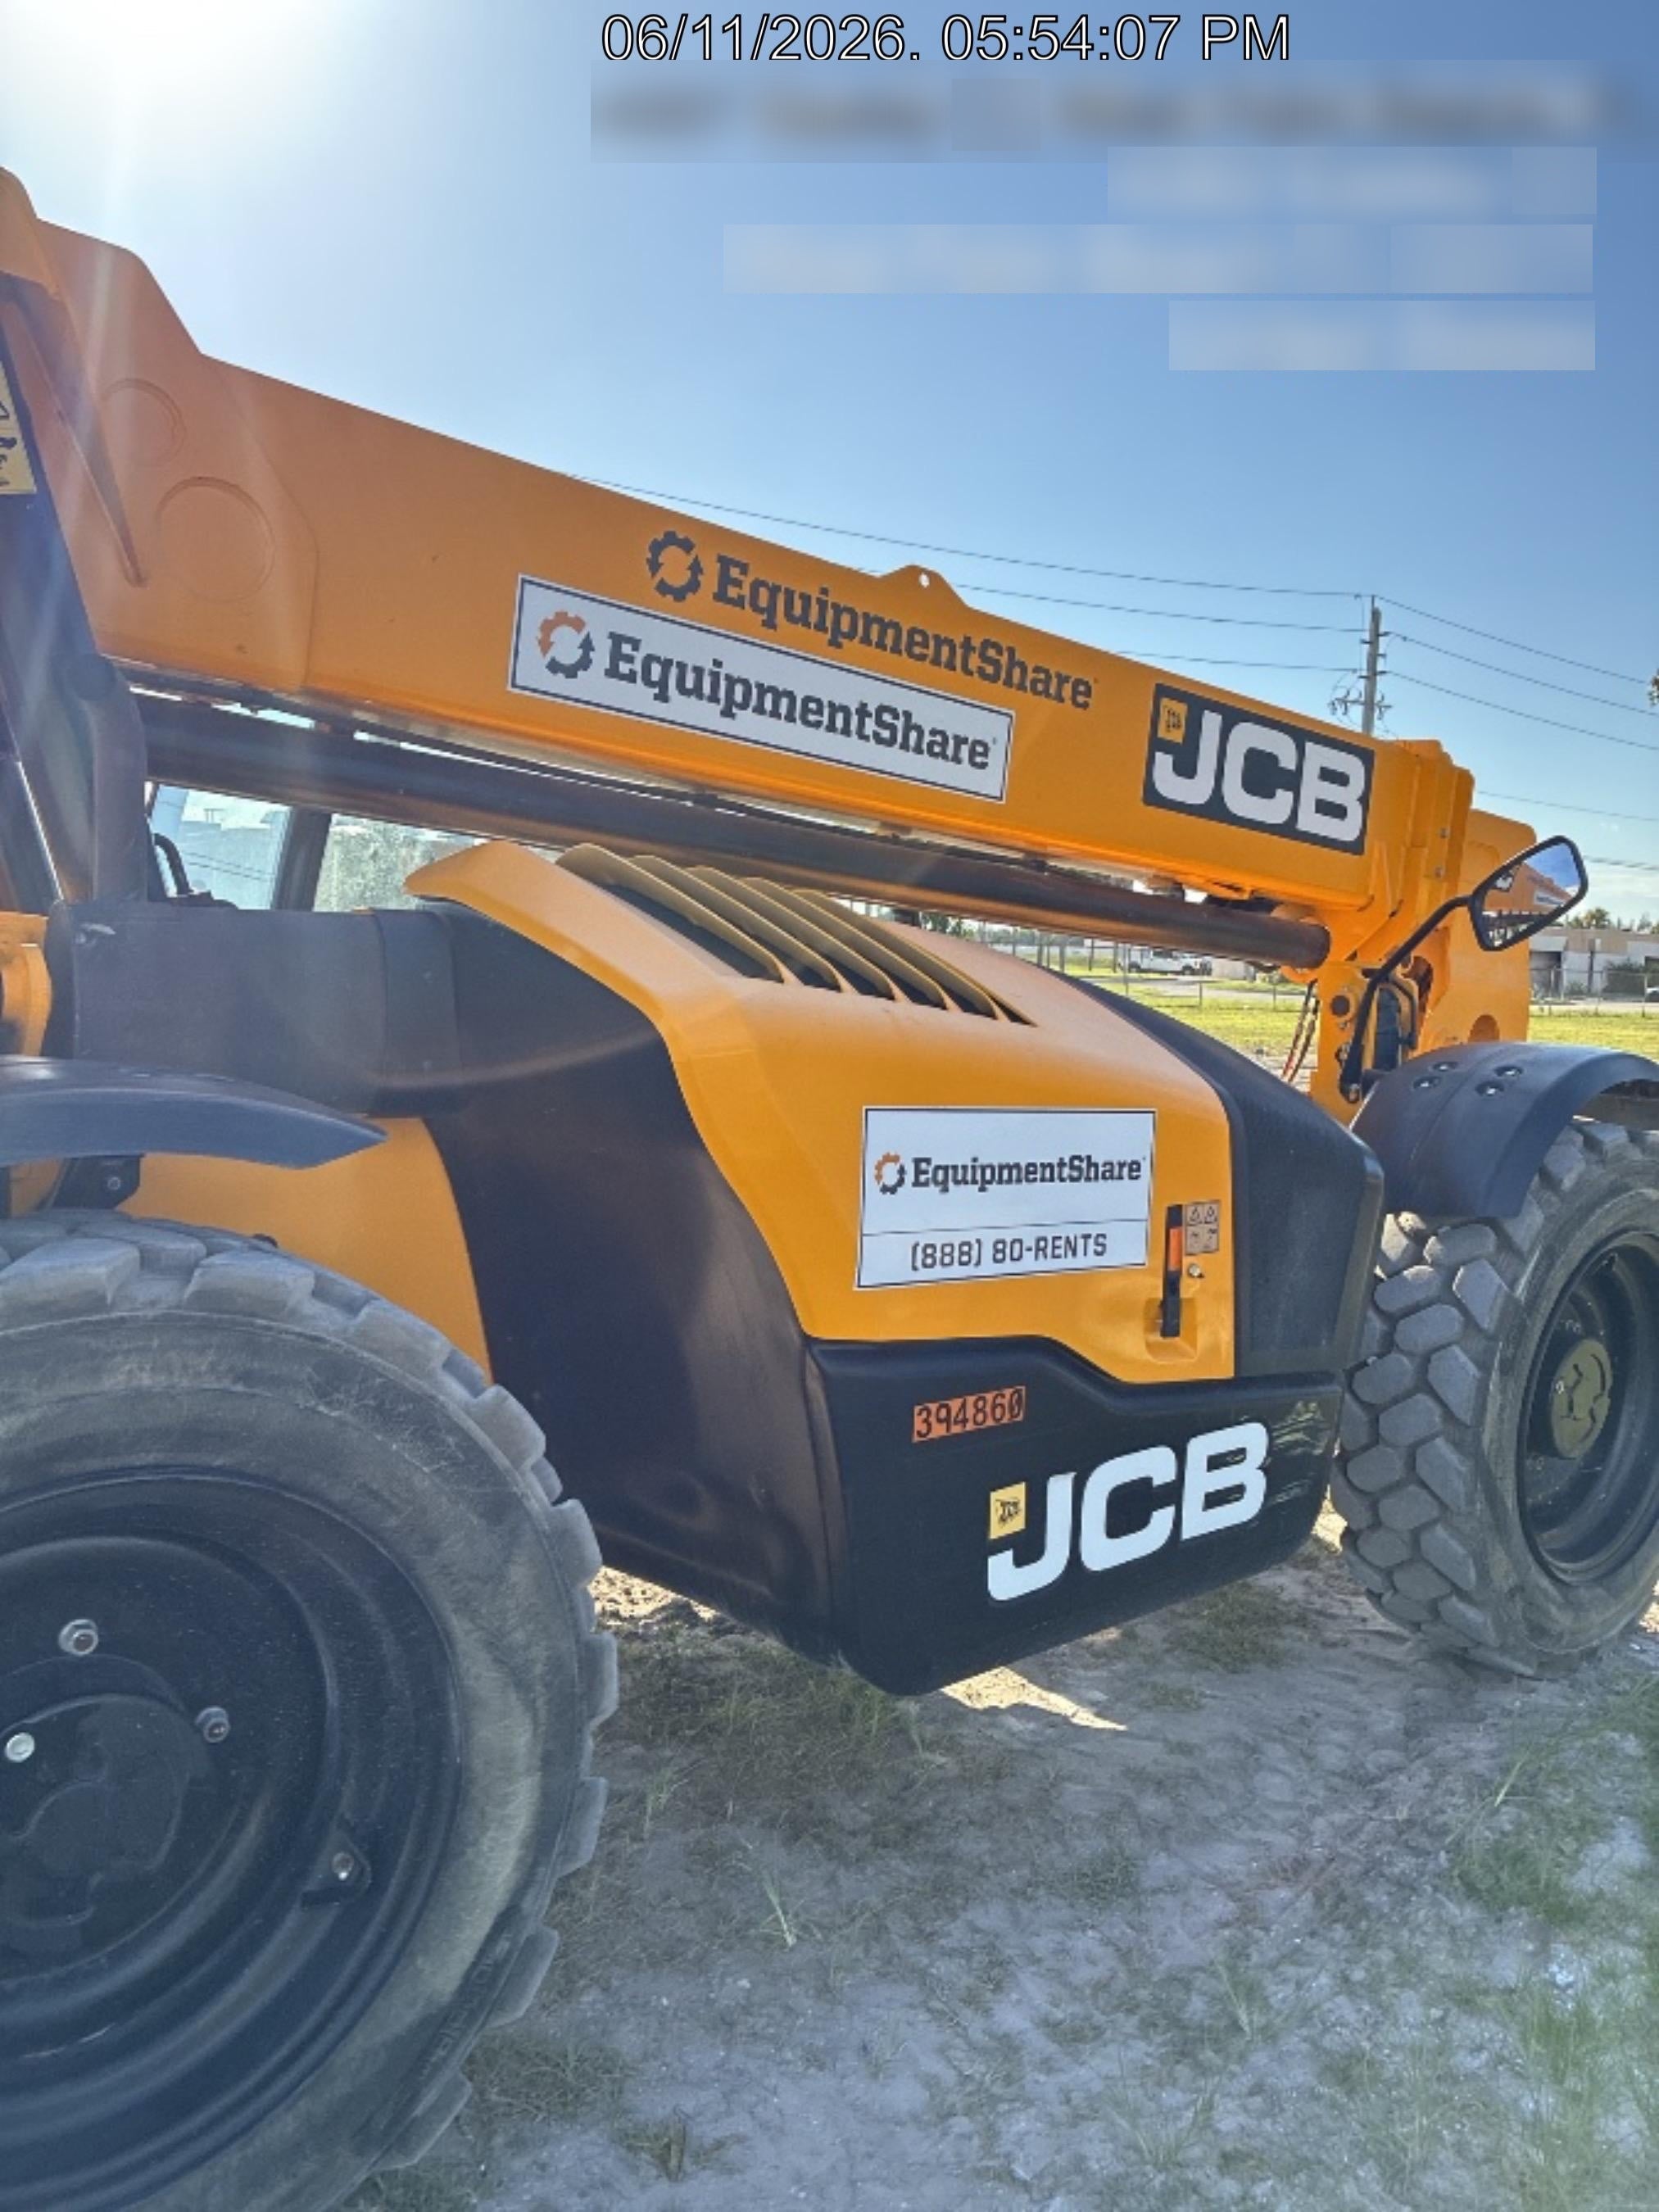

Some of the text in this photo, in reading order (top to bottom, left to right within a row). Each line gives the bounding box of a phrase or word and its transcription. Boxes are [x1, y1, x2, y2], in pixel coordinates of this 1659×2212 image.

[713, 554, 1092, 710] EquipmentShare
[604, 631, 990, 769] EquipmentShare
[1152, 709, 1366, 841] JCB
[911, 1154, 1142, 1193] EquipmentShare
[911, 1234, 1108, 1271] (888) 80-RENTS
[916, 1389, 1023, 1438] 394860
[987, 1421, 1270, 1602] JCB
